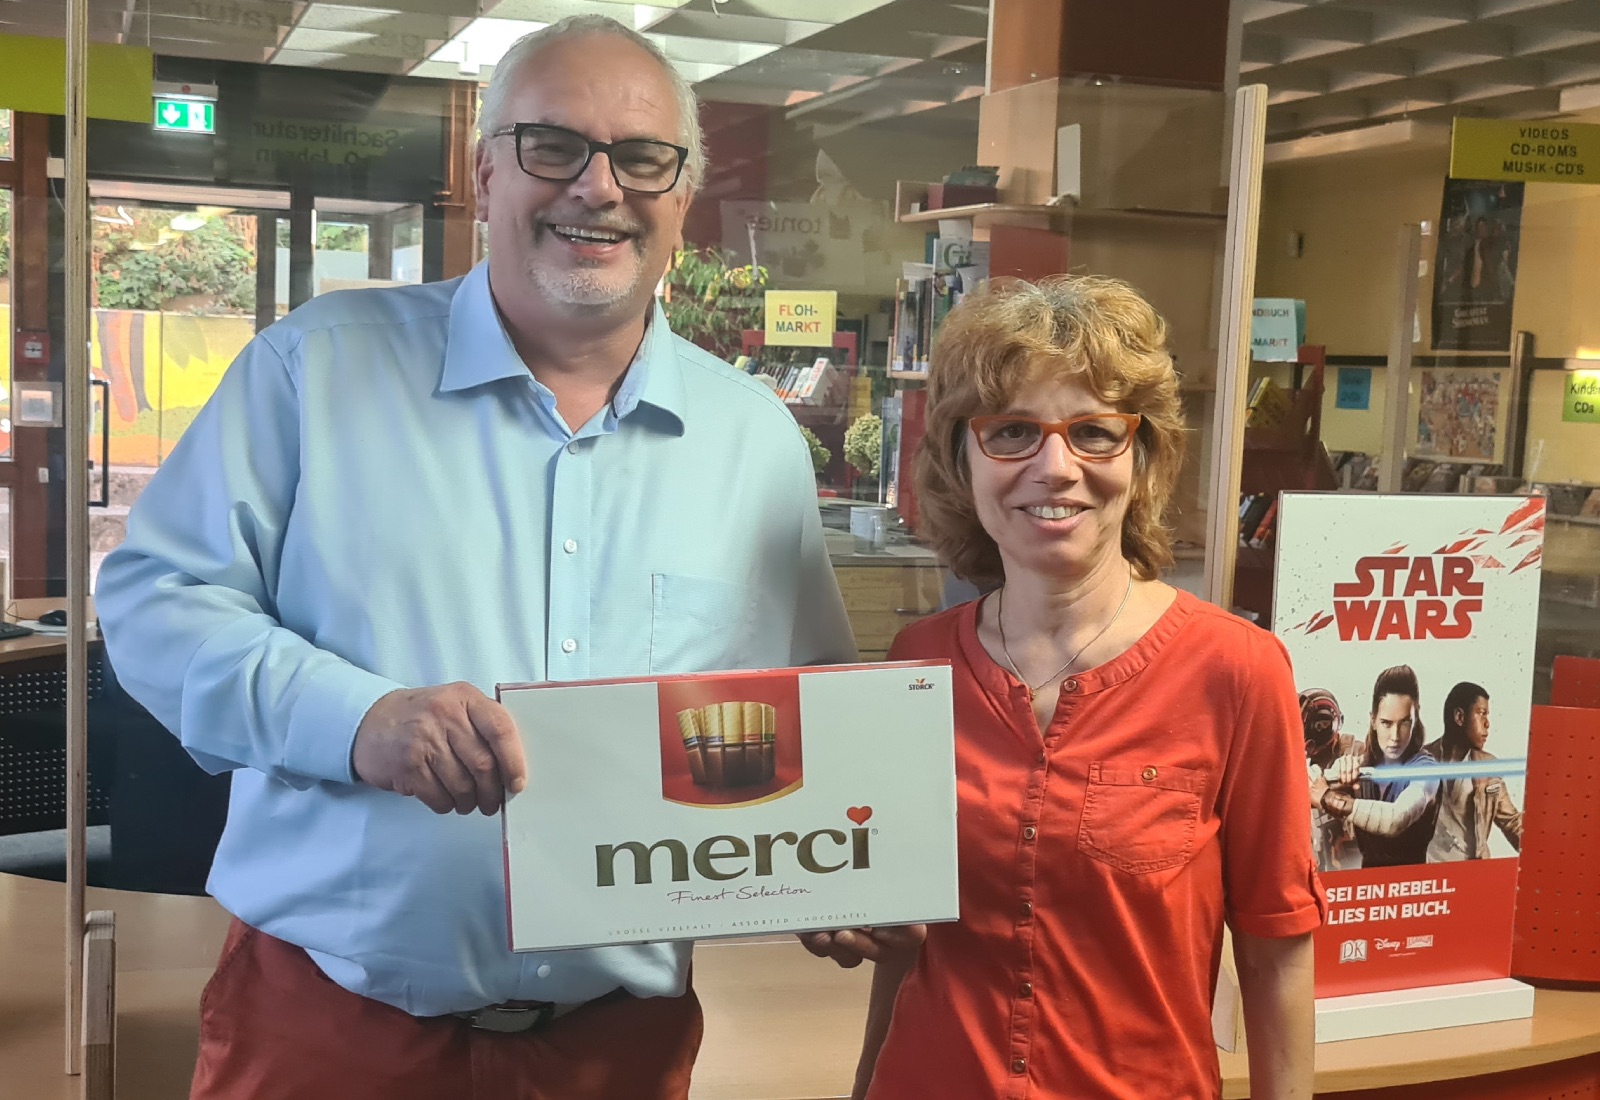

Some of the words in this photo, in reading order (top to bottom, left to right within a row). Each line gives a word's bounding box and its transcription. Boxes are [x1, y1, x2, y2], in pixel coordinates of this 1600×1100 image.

[1520, 127, 1569, 140] VIDEOS
[779, 304, 818, 317] FLOH-
[776, 321, 821, 333] MARKT
[1574, 401, 1594, 413] CDs
[1333, 556, 1484, 597] STAR
[1333, 599, 1483, 641] WARS
[908, 683, 935, 691] STORCK
[595, 806, 873, 887] merci
[667, 888, 735, 904] Finest
[736, 884, 812, 900] Selection
[1326, 887, 1352, 903] SEI
[1356, 884, 1385, 900] EIN
[1388, 879, 1456, 898] REBELL.
[1328, 908, 1366, 925] LIES
[1369, 905, 1398, 921] EIN
[1401, 900, 1451, 919] BUCH.
[1342, 941, 1364, 959] DK
